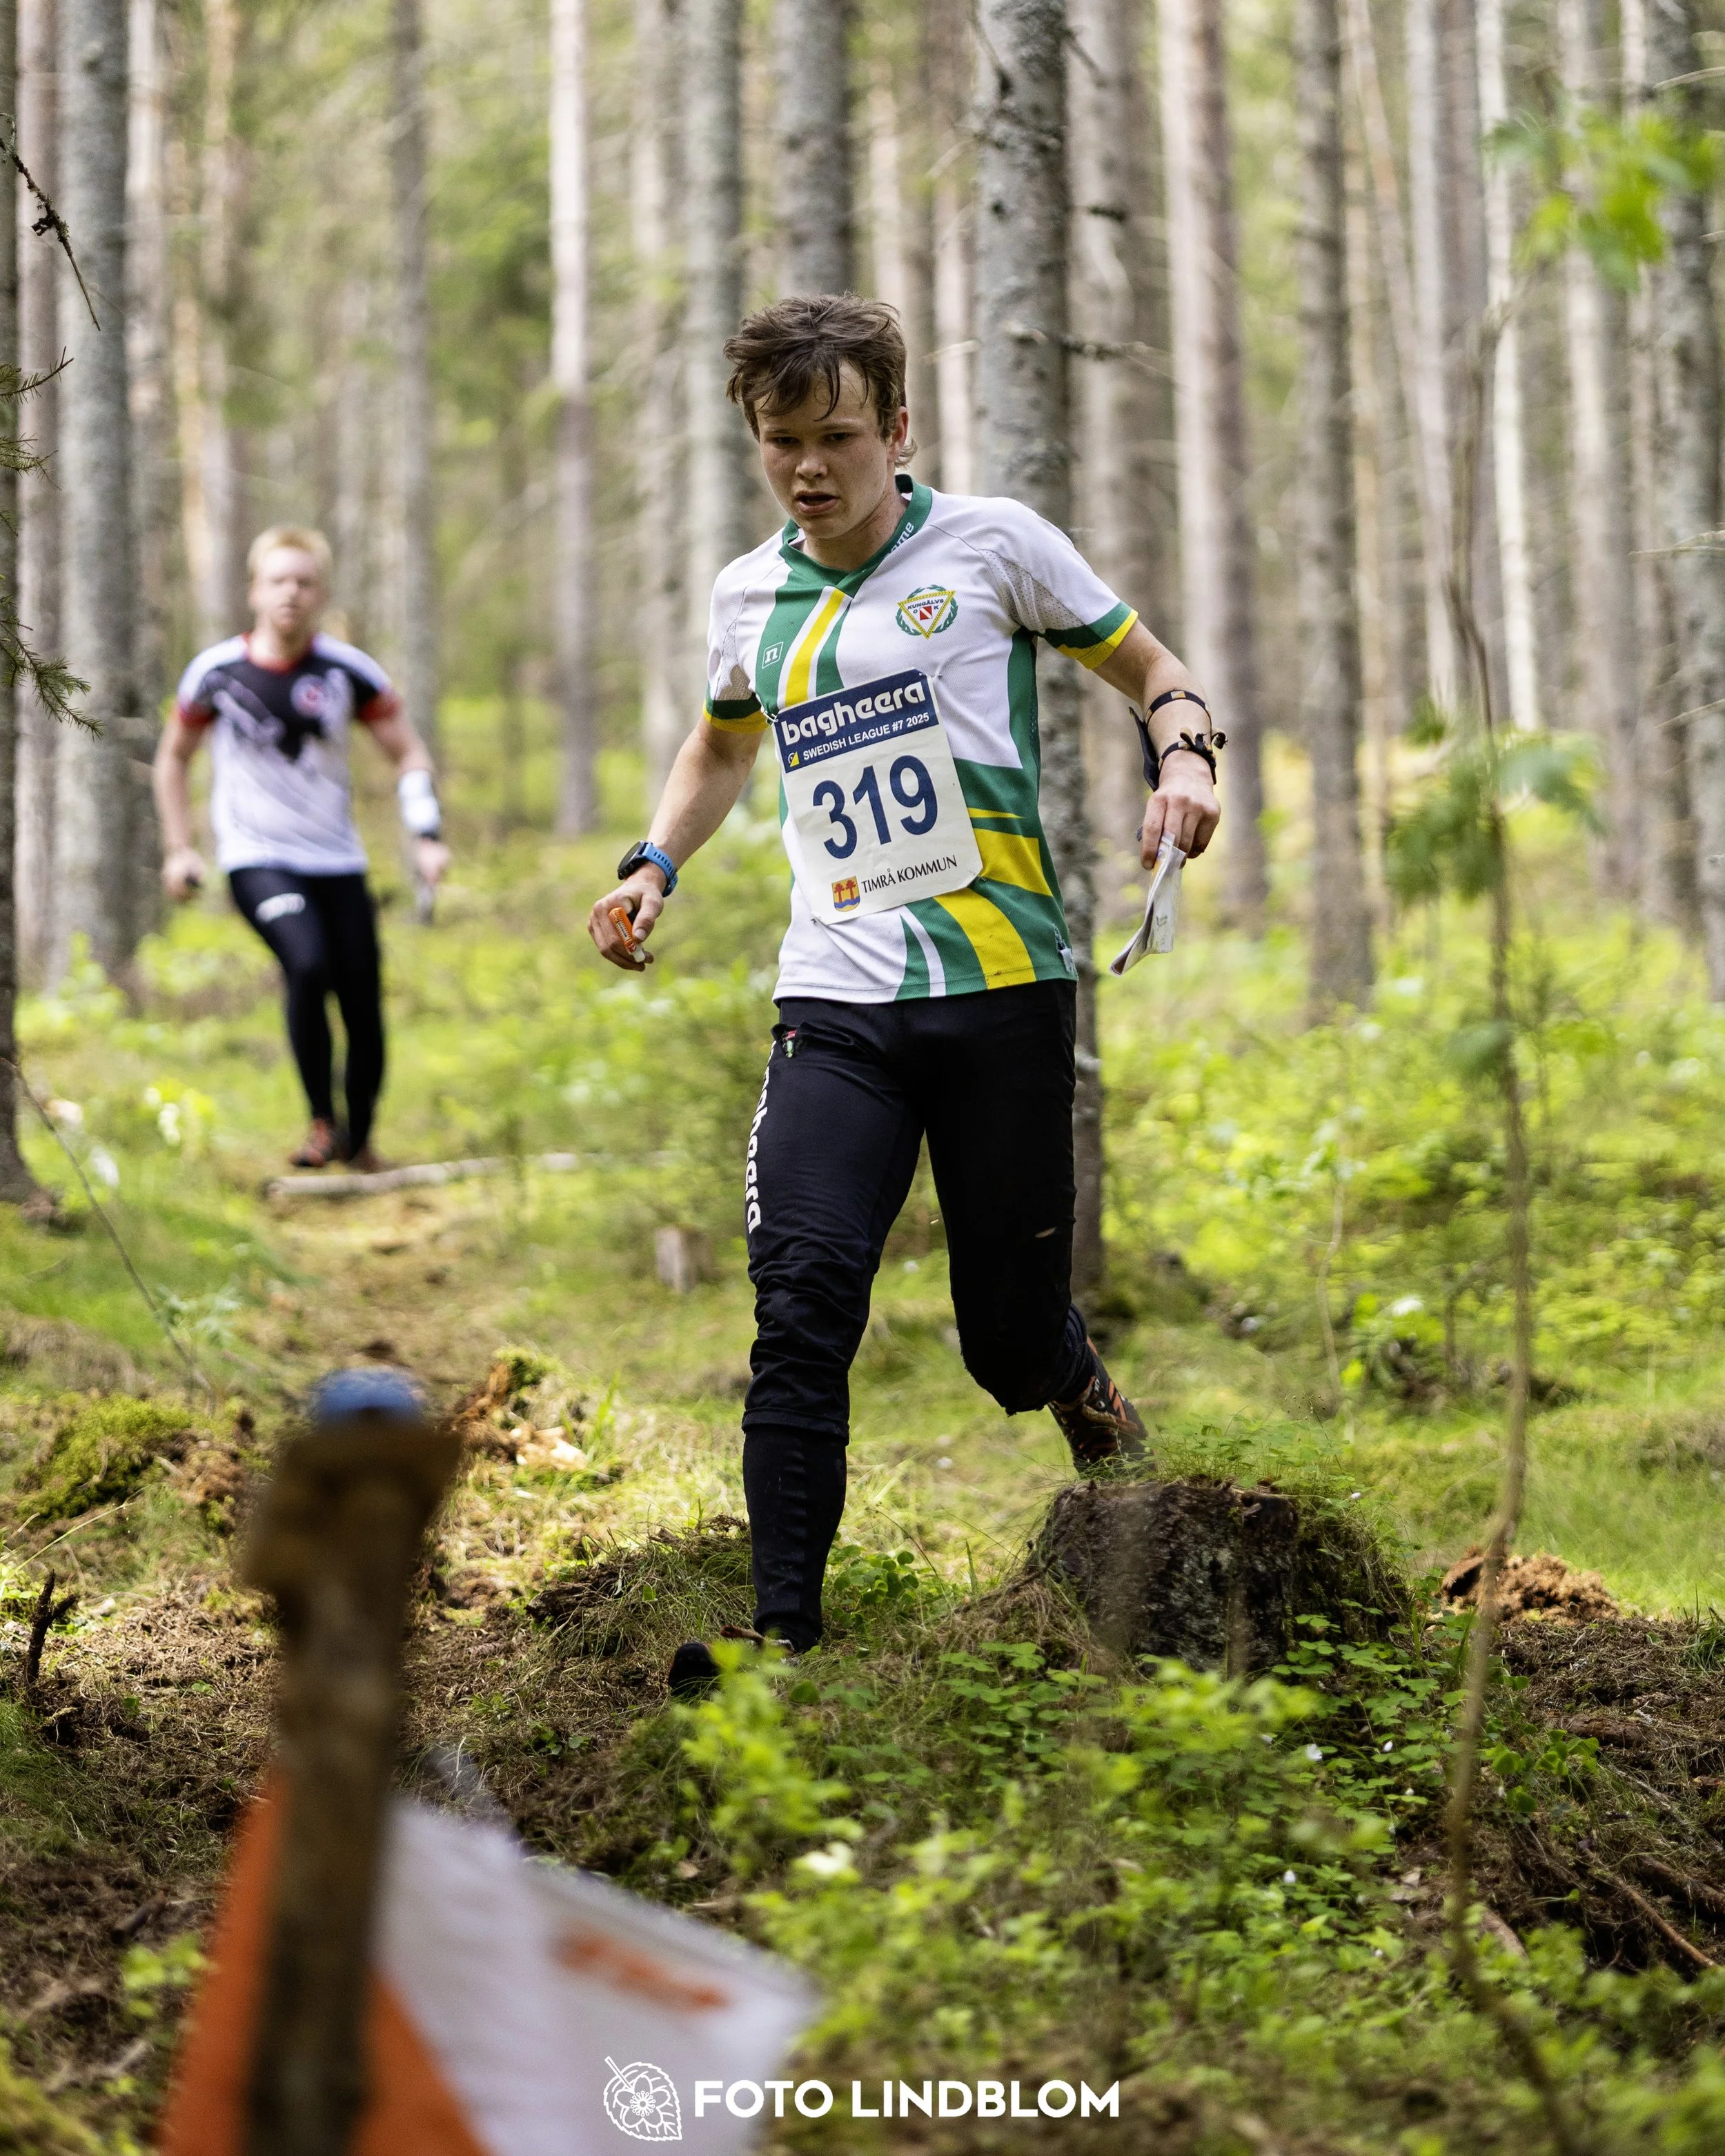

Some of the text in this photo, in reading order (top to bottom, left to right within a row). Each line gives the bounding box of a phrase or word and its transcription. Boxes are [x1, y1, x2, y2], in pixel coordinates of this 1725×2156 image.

[781, 681, 926, 746] bagheera
[802, 712, 930, 760] SWEDISH LEAGUE #7 2025
[813, 754, 938, 860] 319
[861, 854, 958, 893] TIMRÅ KOMMUN
